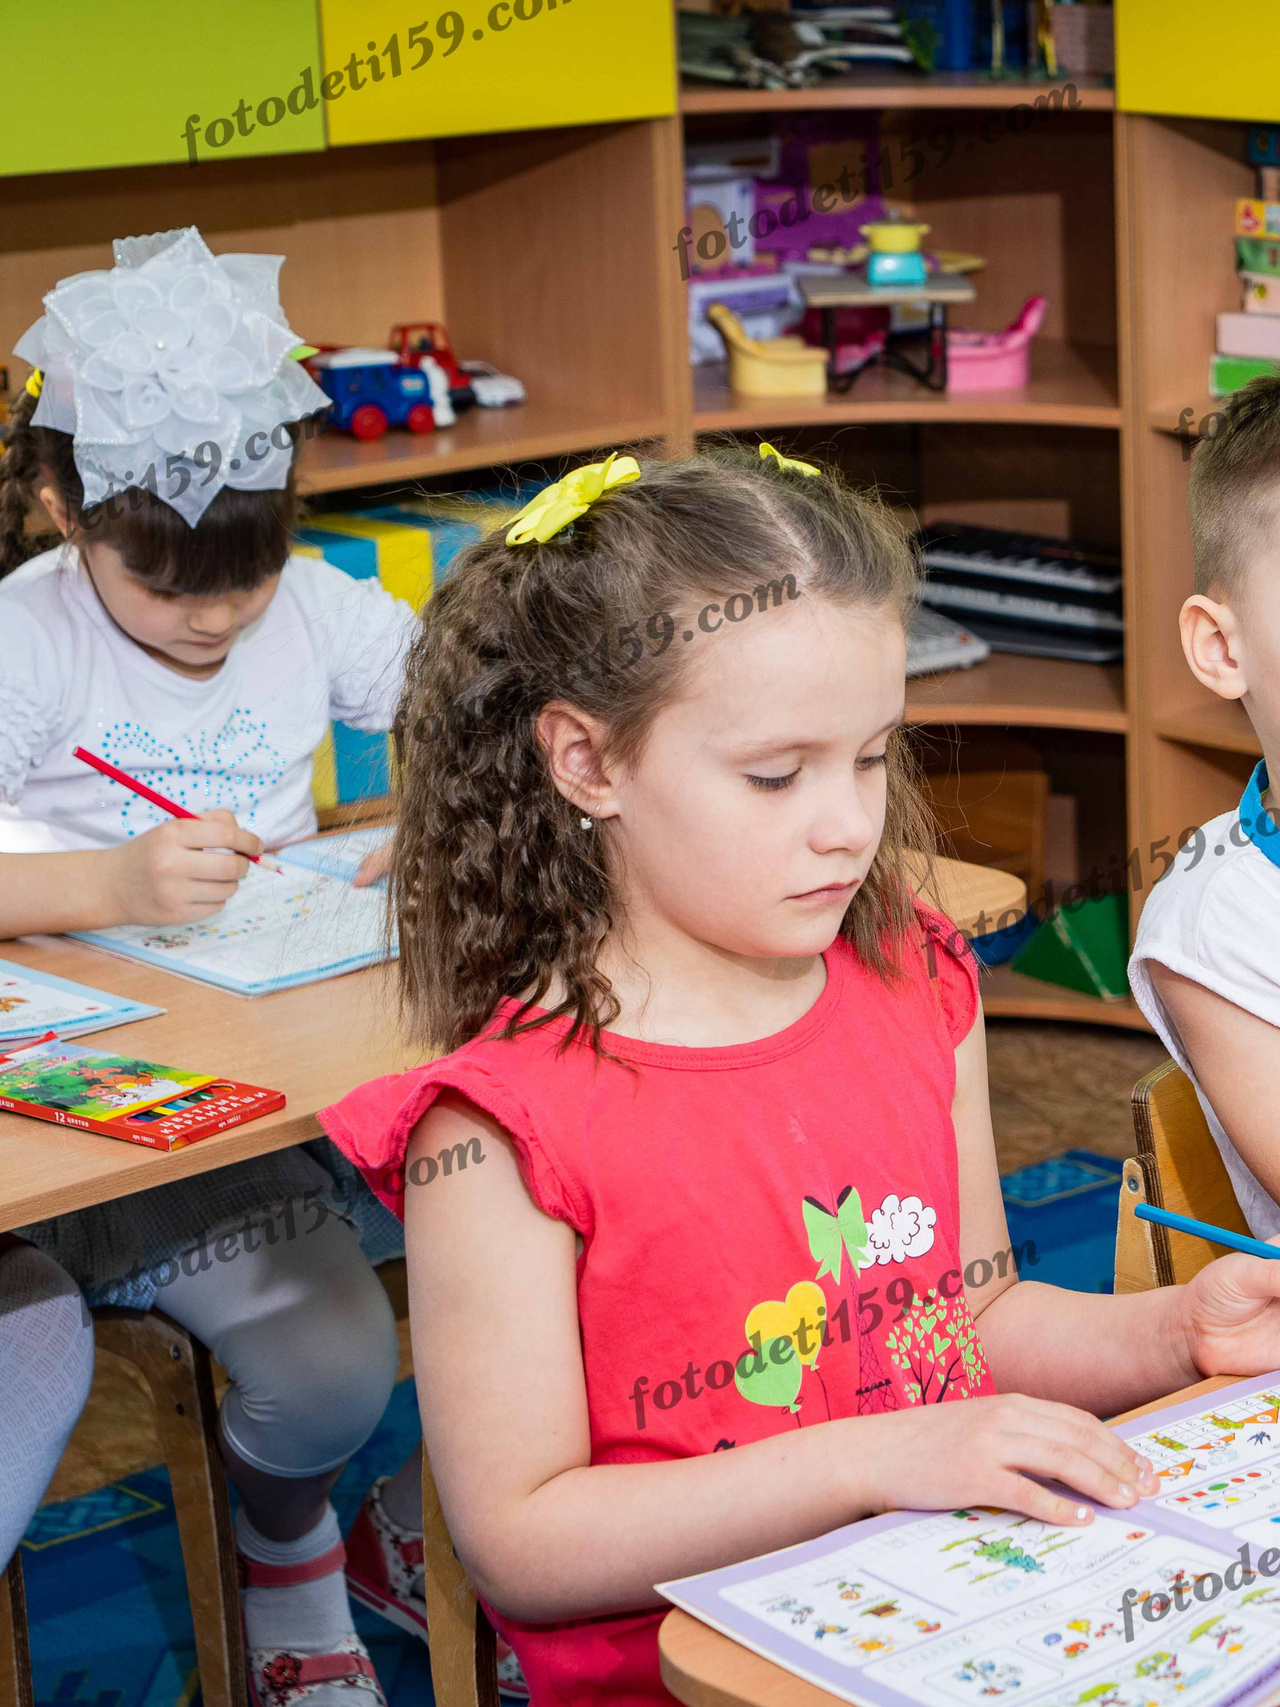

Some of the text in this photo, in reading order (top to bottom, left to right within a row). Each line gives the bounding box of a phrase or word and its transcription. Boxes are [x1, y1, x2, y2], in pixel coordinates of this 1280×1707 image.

[54, 1111, 66, 1123] 12
[159, 1094, 240, 1129] ЦВЕТНЫЕ
[160, 1091, 268, 1135] КАРАНДАШИ
